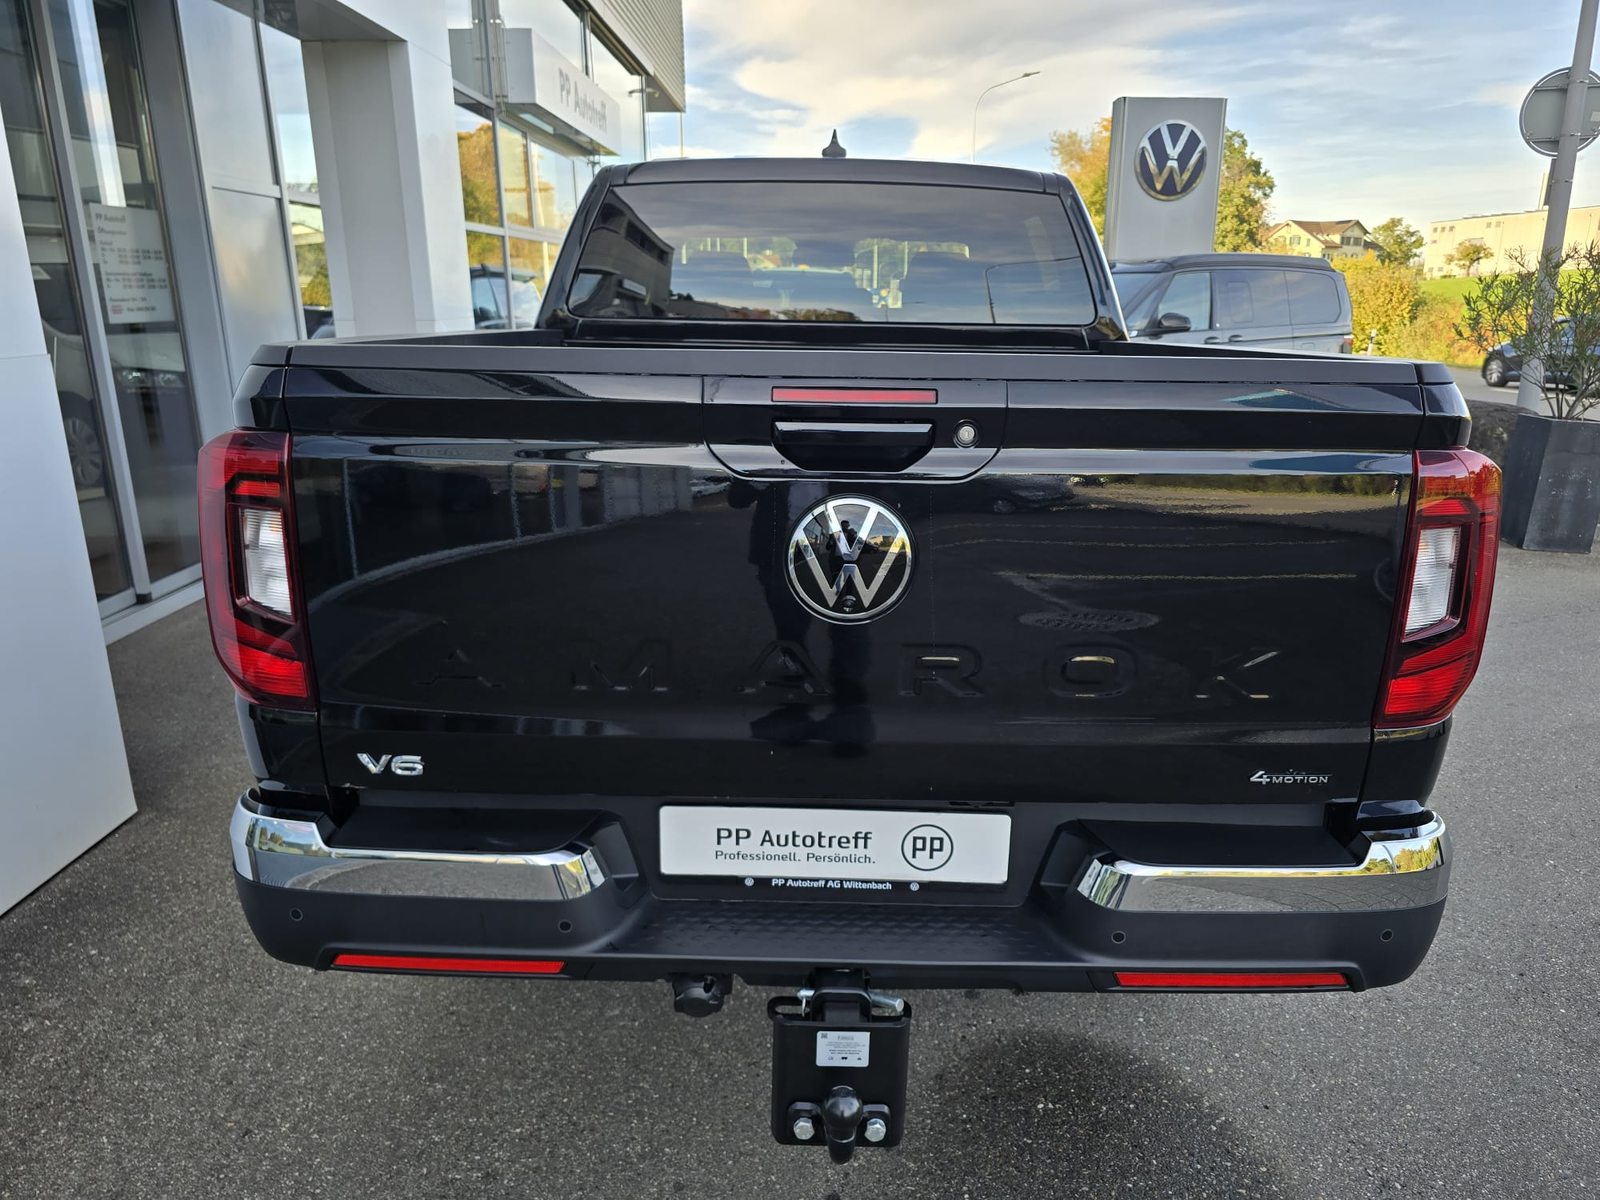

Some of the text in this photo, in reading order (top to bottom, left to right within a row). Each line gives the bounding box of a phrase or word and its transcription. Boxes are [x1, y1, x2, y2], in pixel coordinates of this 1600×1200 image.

[558, 67, 607, 134] PP Autotreff
[787, 497, 912, 620] VW
[415, 637, 1280, 698] AMAROK
[357, 753, 424, 776] V6
[716, 828, 872, 849] PP Autotreff
[715, 850, 876, 864] Professionell. Persönlich.
[771, 879, 892, 890] PP Autotreff AG Wittenbach
